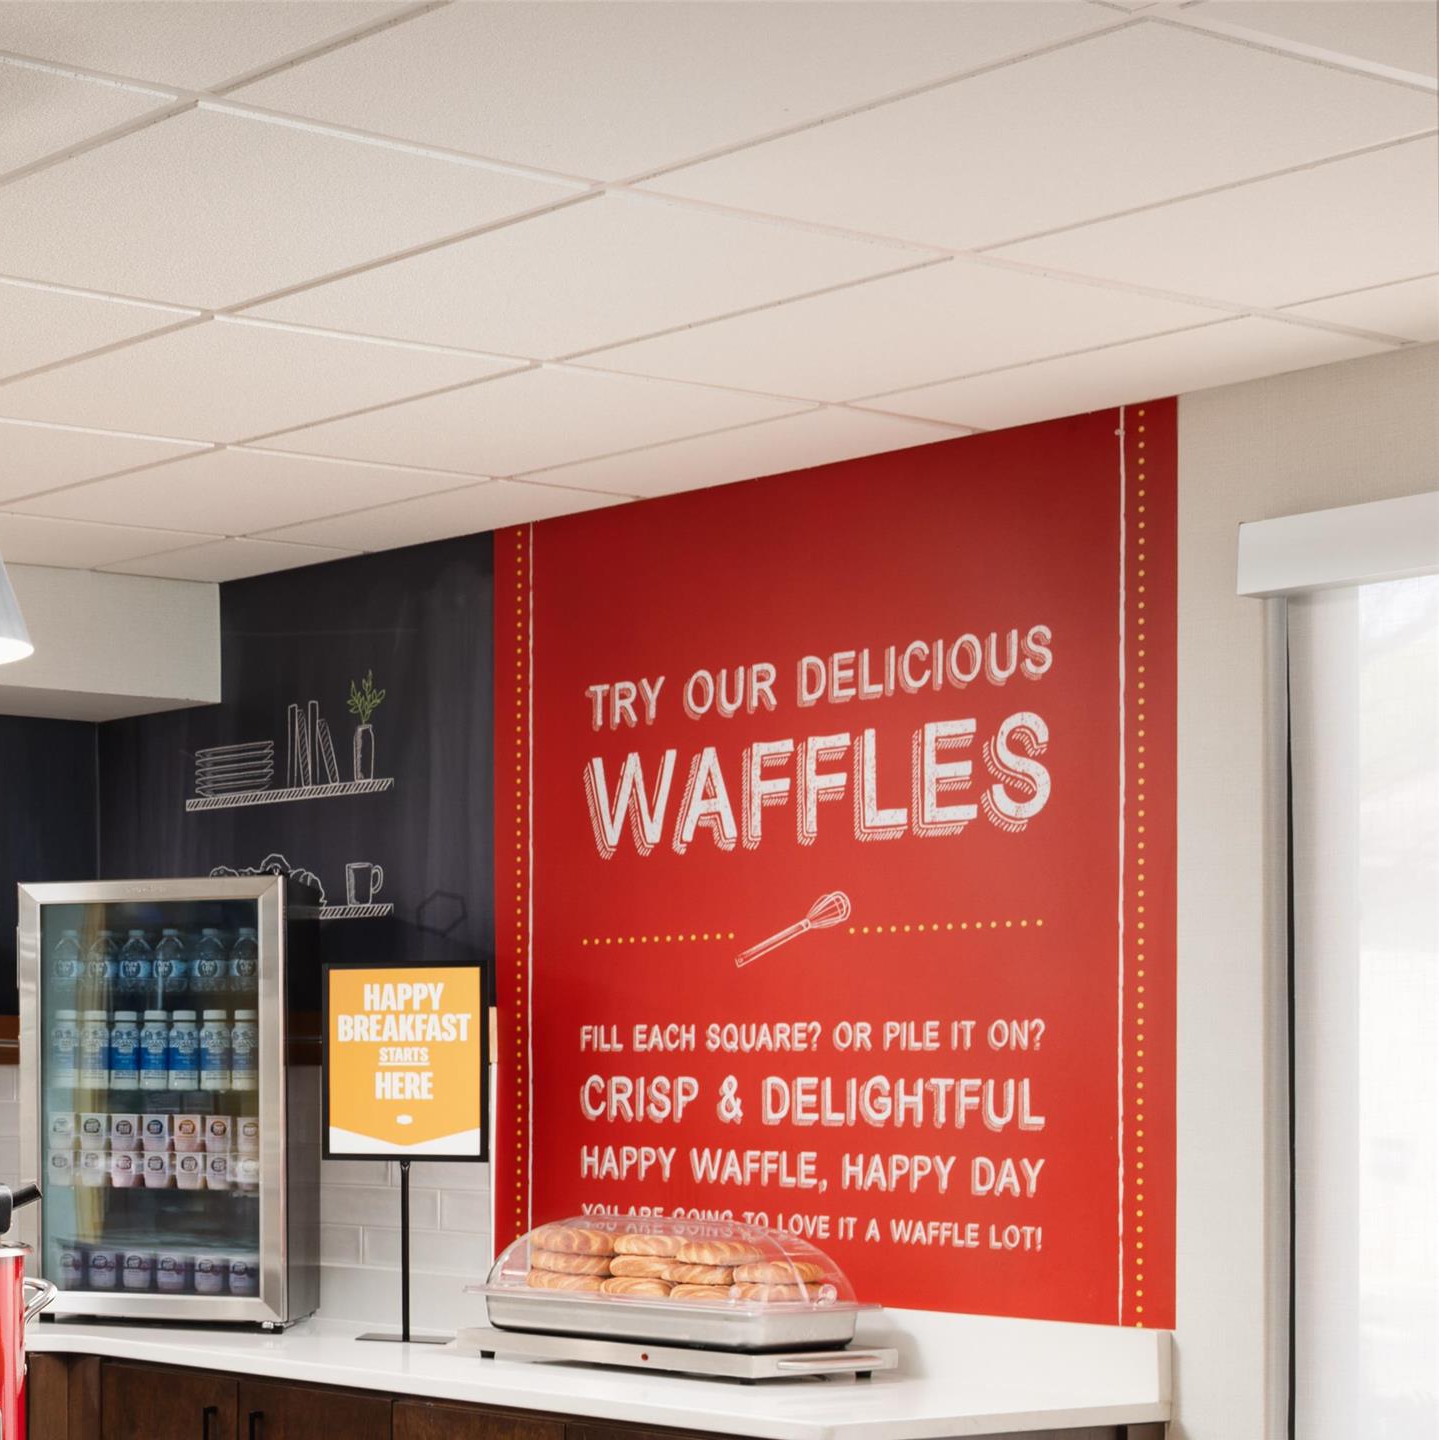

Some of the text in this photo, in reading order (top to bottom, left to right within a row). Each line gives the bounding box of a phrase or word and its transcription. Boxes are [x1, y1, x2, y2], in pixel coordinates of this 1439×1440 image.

[584, 624, 1053, 732] TRY OUR DELICIOUS
[583, 711, 1052, 860] WAFFLES
[363, 983, 444, 1011] HAPPY
[337, 1013, 471, 1042] BREAKFAST
[580, 1018, 1045, 1052] FILL EACH SQUARE? OR PILE IT ON?
[379, 1047, 429, 1062] STARTS
[375, 1071, 434, 1100] HERE
[580, 1074, 1045, 1132] CRISP & DELIGHTFUL
[581, 1145, 1045, 1198] HAPPY WAFFLE, HAPPY DAY
[582, 1203, 1043, 1252] YOU ARE GOING TO LOVE IT A WAFFLE LOT!
